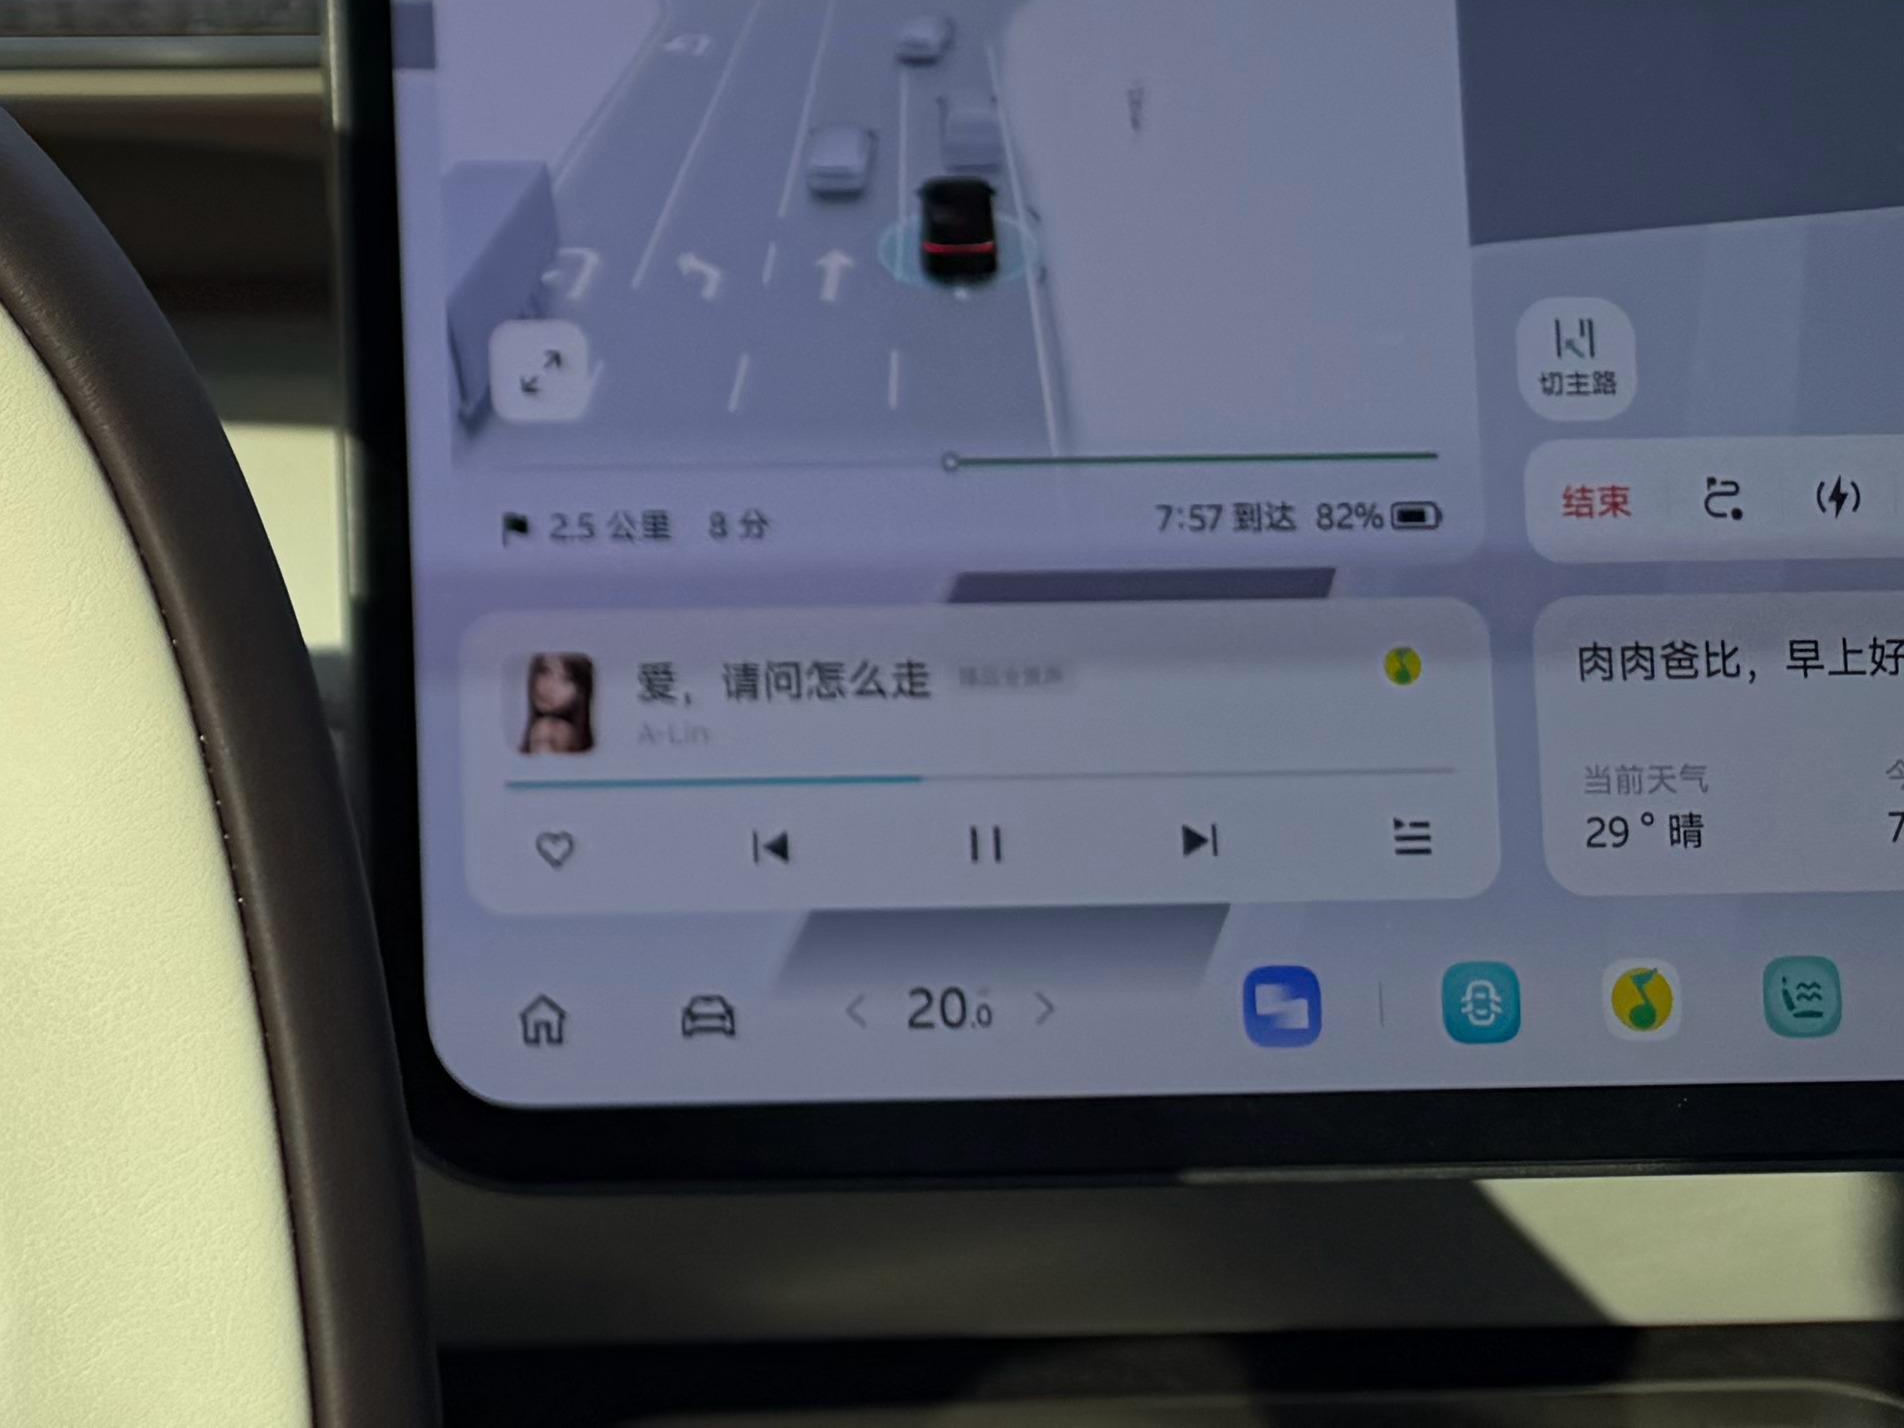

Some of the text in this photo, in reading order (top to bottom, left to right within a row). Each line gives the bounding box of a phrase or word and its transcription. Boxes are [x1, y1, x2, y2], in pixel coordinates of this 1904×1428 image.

[1538, 371, 1616, 396] 切主路
[1155, 501, 1384, 534] 7:57 到达 82%
[1562, 484, 1631, 519] 结束
[549, 508, 770, 542] 2.5 公里 8 分
[637, 659, 933, 704] 爱，请问怎么走
[1584, 763, 1709, 796] 当前天气
[1669, 812, 1704, 849] 晴
